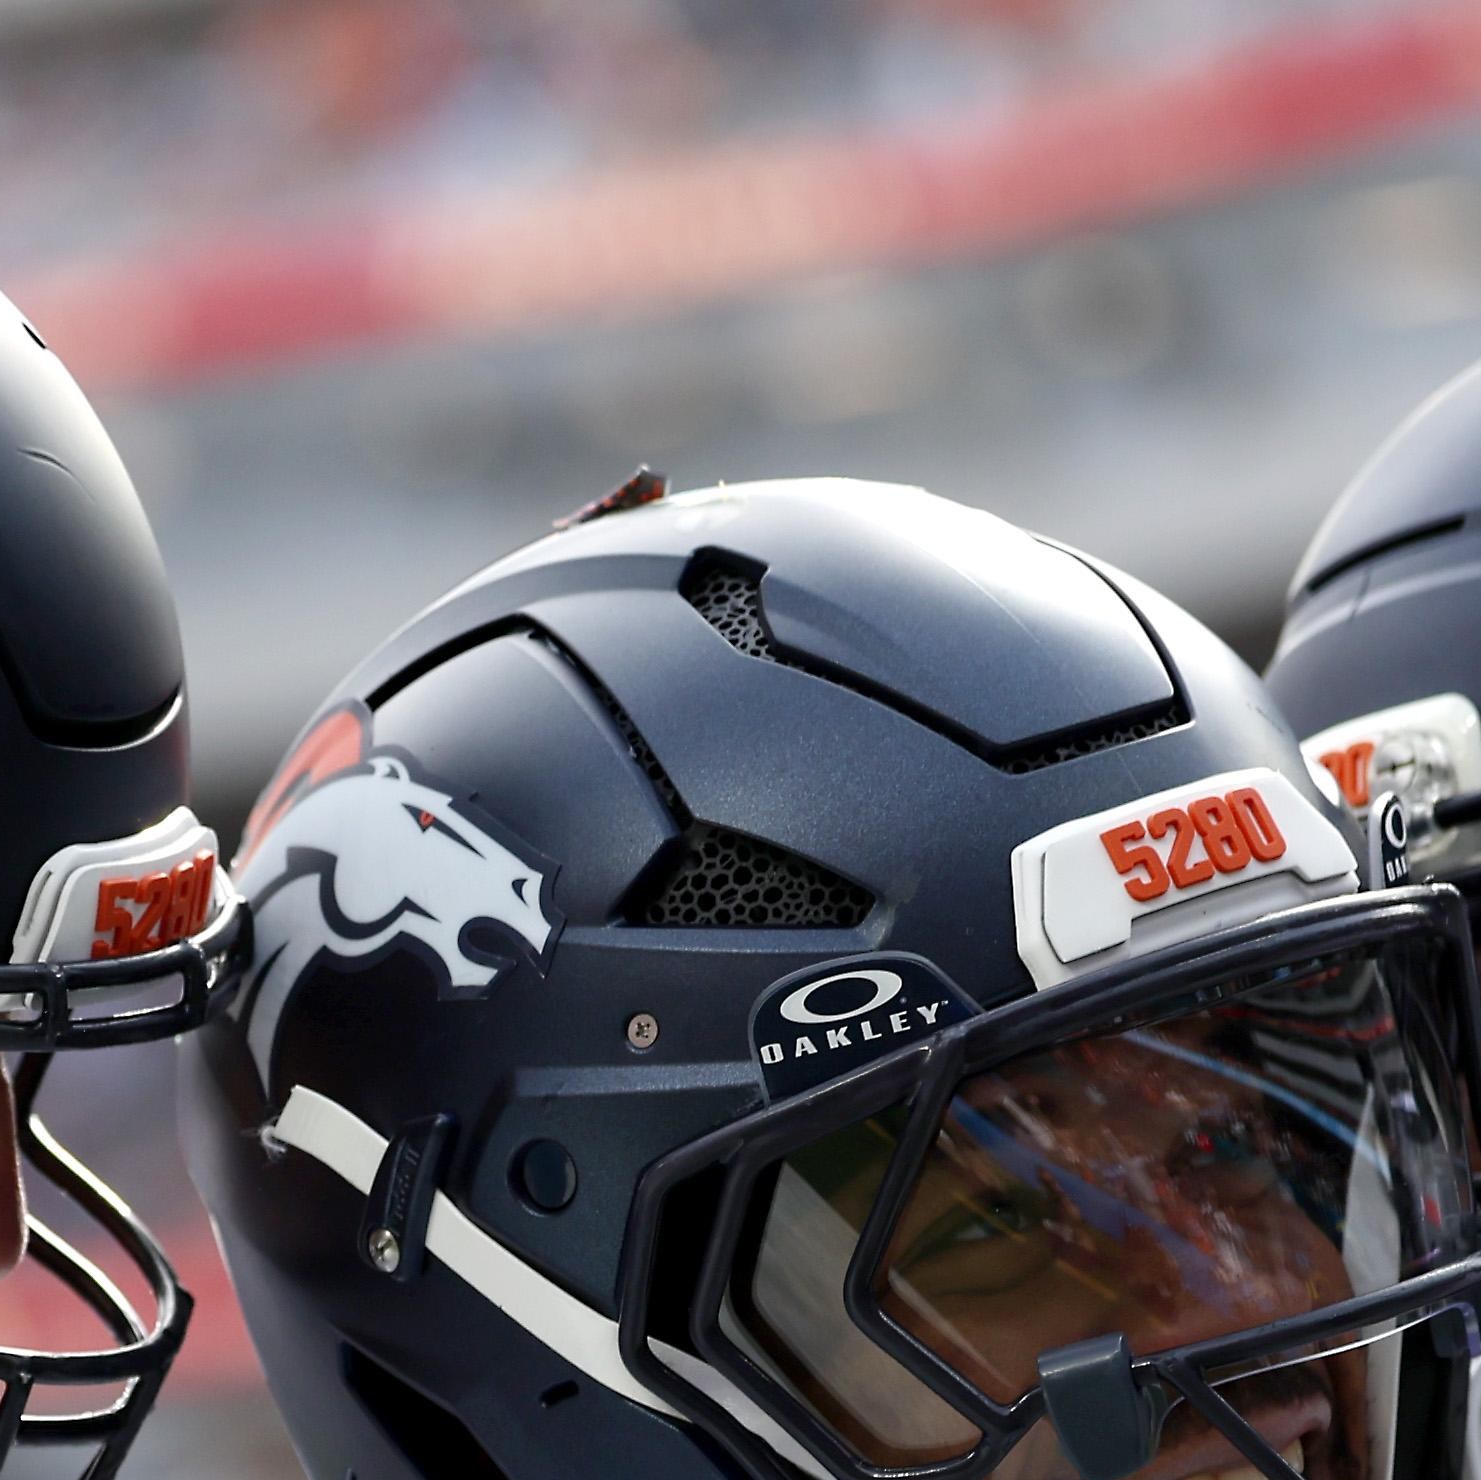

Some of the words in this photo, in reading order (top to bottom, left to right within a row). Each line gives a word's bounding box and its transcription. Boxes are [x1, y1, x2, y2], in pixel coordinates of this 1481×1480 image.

[1100, 787, 1287, 902] 5280
[90, 848, 214, 960] 5280
[760, 1002, 940, 1065] OAKLEY
